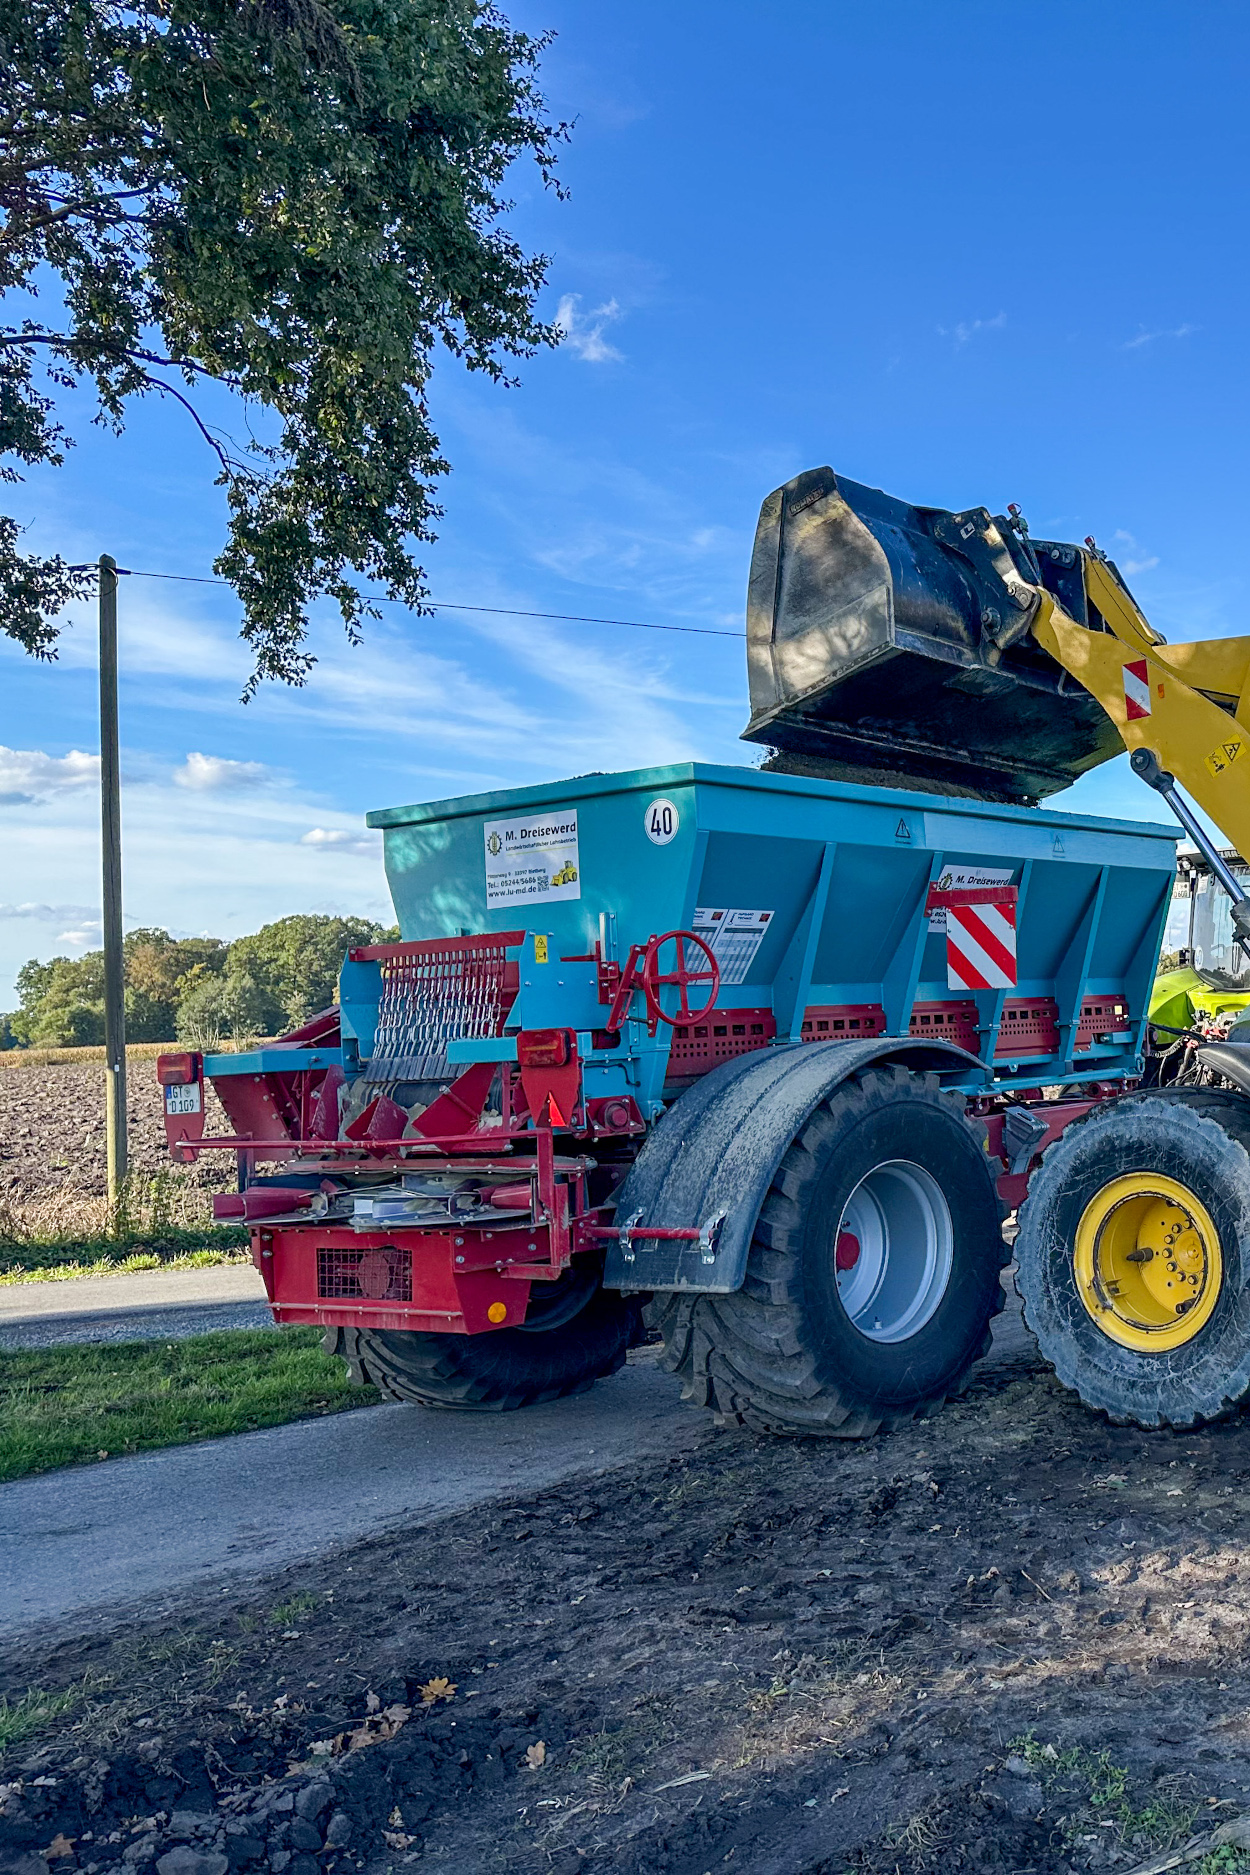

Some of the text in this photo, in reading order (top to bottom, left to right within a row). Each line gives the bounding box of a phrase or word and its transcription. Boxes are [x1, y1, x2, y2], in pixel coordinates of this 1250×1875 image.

[651, 807, 672, 836] 40
[505, 821, 576, 841] M. Dreisewerd
[955, 875, 1010, 886] M. Dreisewerd
[488, 885, 537, 897] www.lu-md.de
[172, 1085, 184, 1098] GT
[171, 1100, 177, 1113] D
